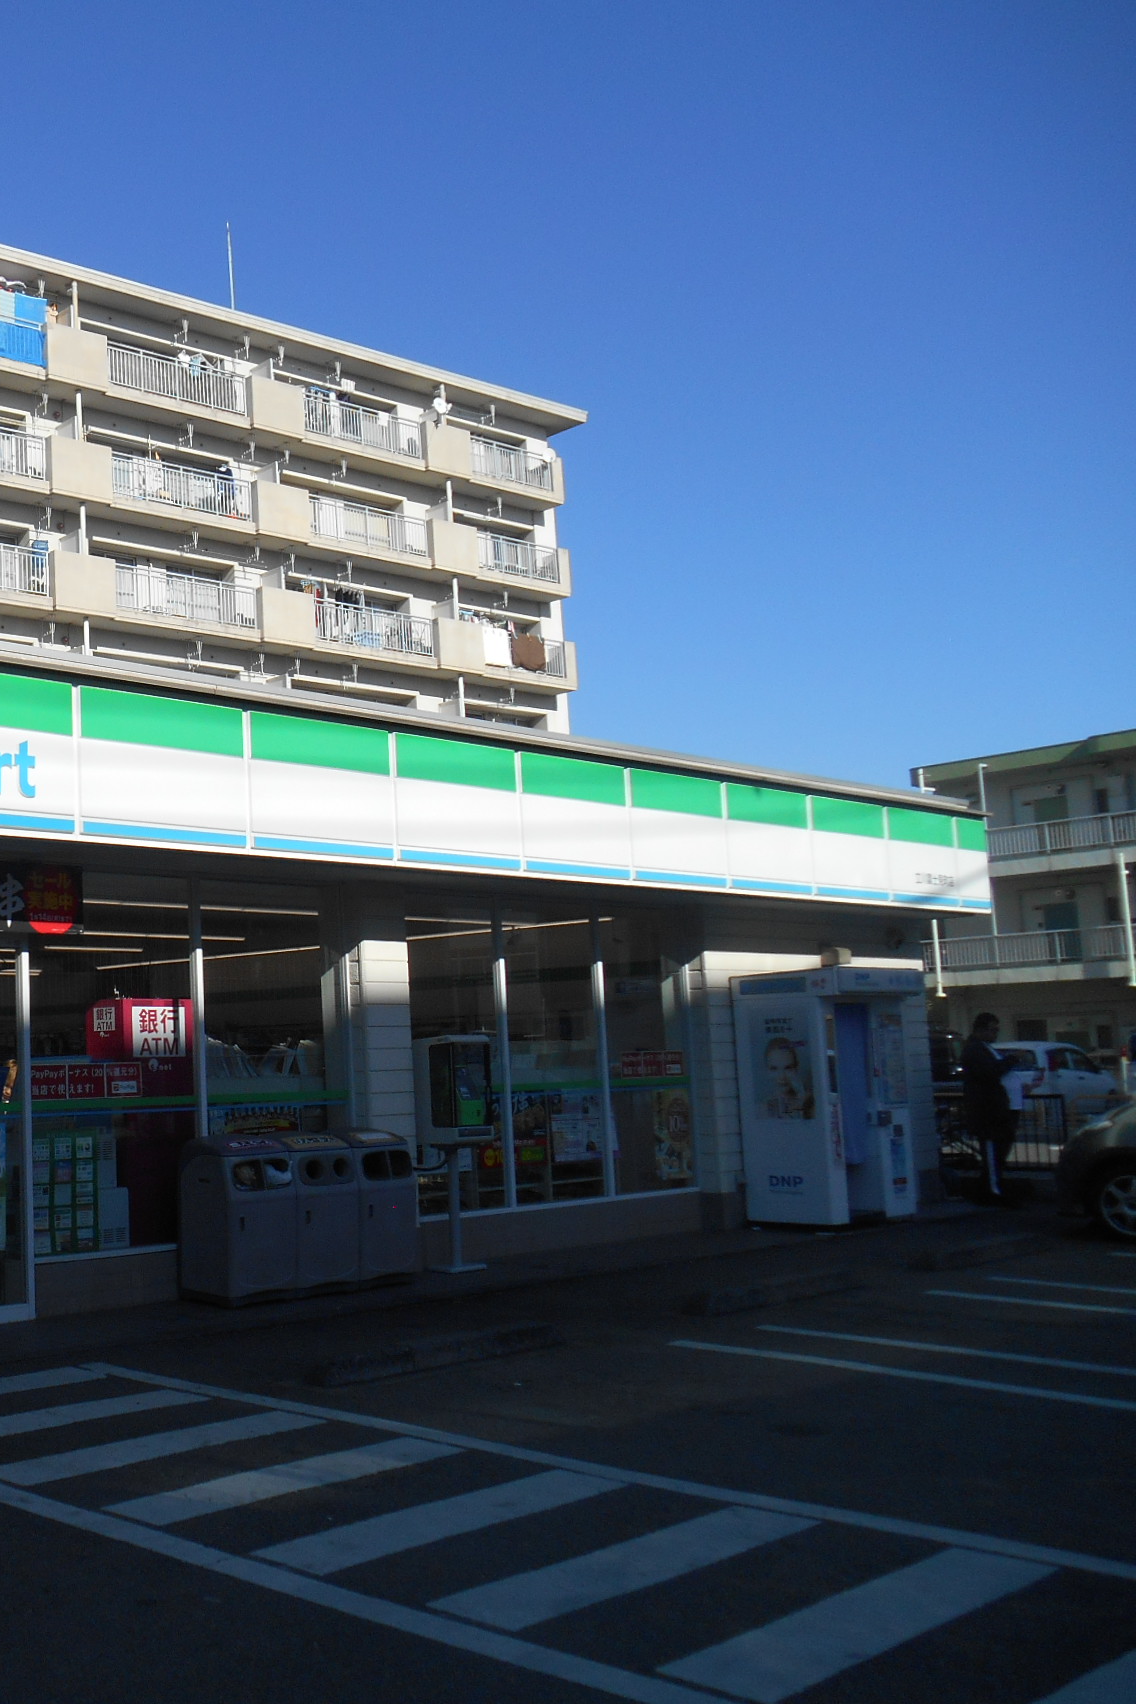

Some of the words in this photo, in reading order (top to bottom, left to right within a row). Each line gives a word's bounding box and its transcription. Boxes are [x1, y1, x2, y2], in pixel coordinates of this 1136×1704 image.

[96, 1008, 113, 1020] 銀行
[96, 1021, 113, 1030] ATM
[139, 1009, 179, 1034] 銀行
[140, 1038, 179, 1055] ATM
[769, 1175, 804, 1187] DNP
